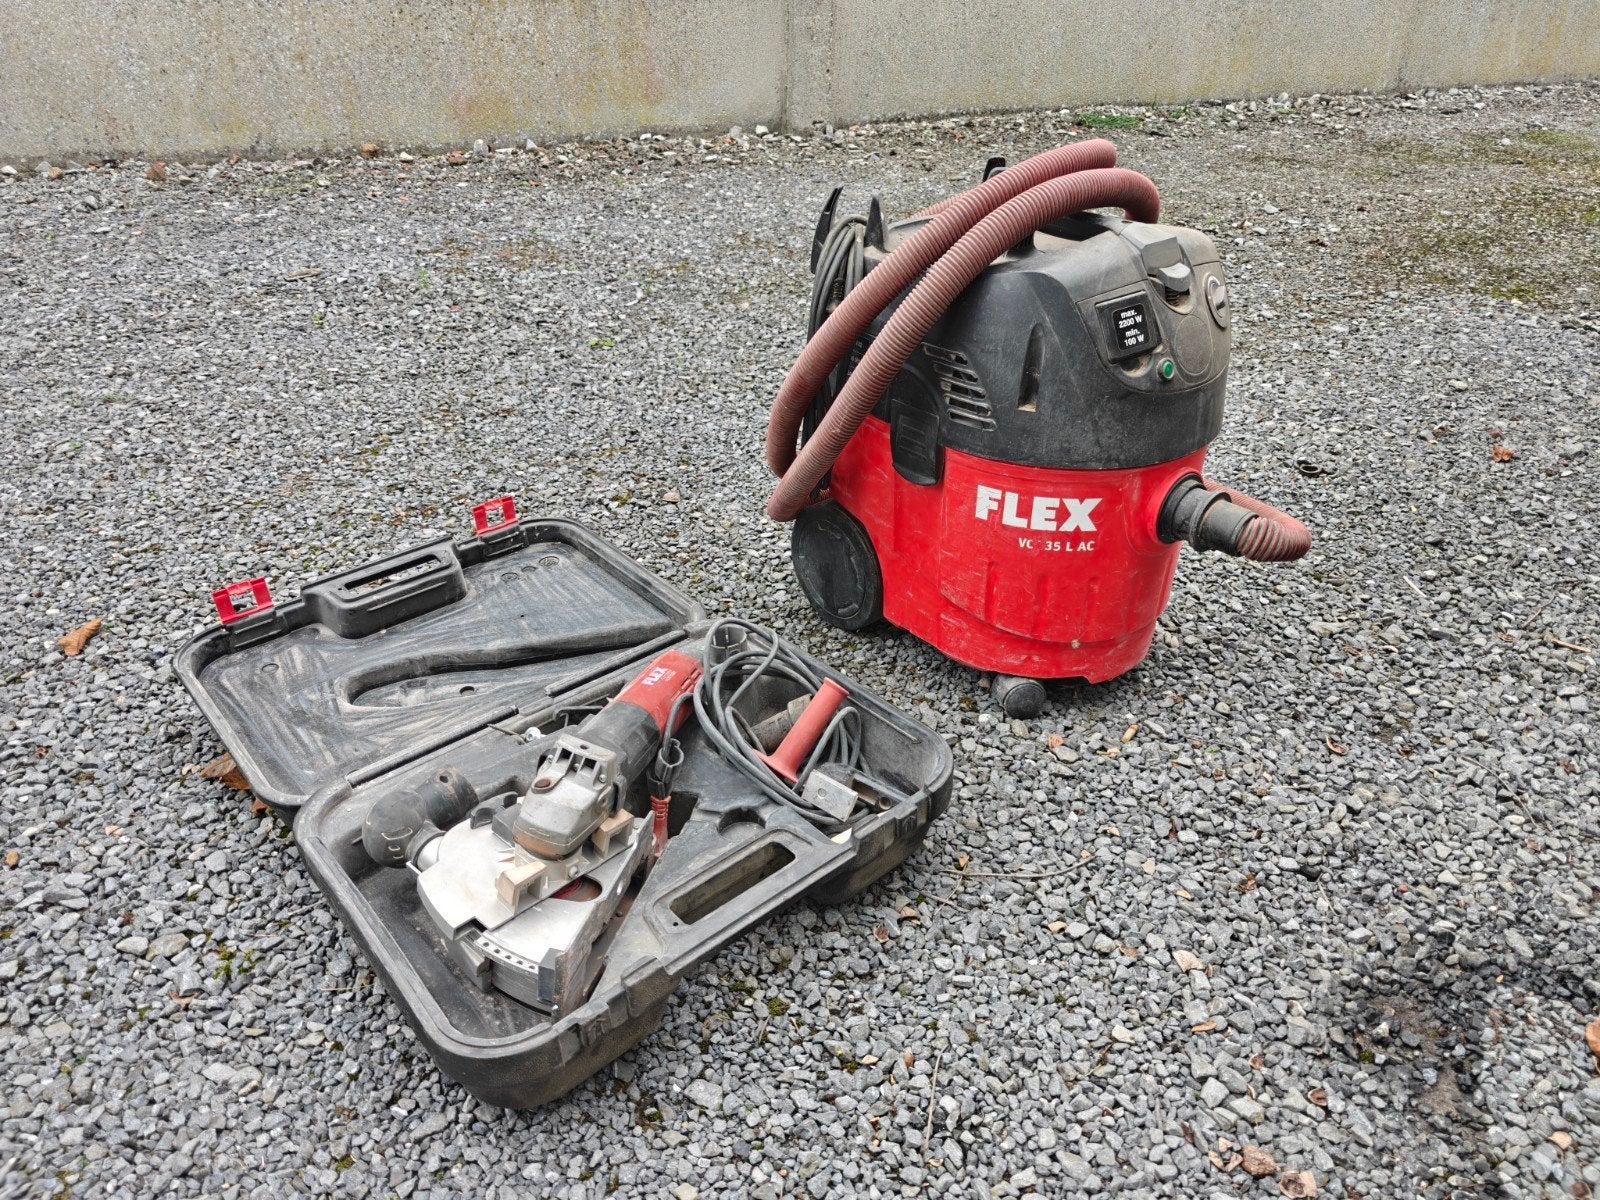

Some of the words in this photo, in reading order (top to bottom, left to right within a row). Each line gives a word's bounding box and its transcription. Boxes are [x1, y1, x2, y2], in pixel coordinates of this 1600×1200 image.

[1120, 309, 1137, 319] max.
[1118, 317, 1135, 329] 2200
[1134, 315, 1142, 323] W
[1125, 328, 1140, 338] min.
[1124, 336, 1137, 347] 100
[1136, 334, 1144, 343] W
[975, 484, 1103, 532] FLEX
[1018, 537, 1042, 549] VC
[1044, 540, 1061, 552] 35
[1065, 541, 1073, 552] L
[1076, 540, 1095, 552] AC
[641, 666, 669, 686] FLEX
